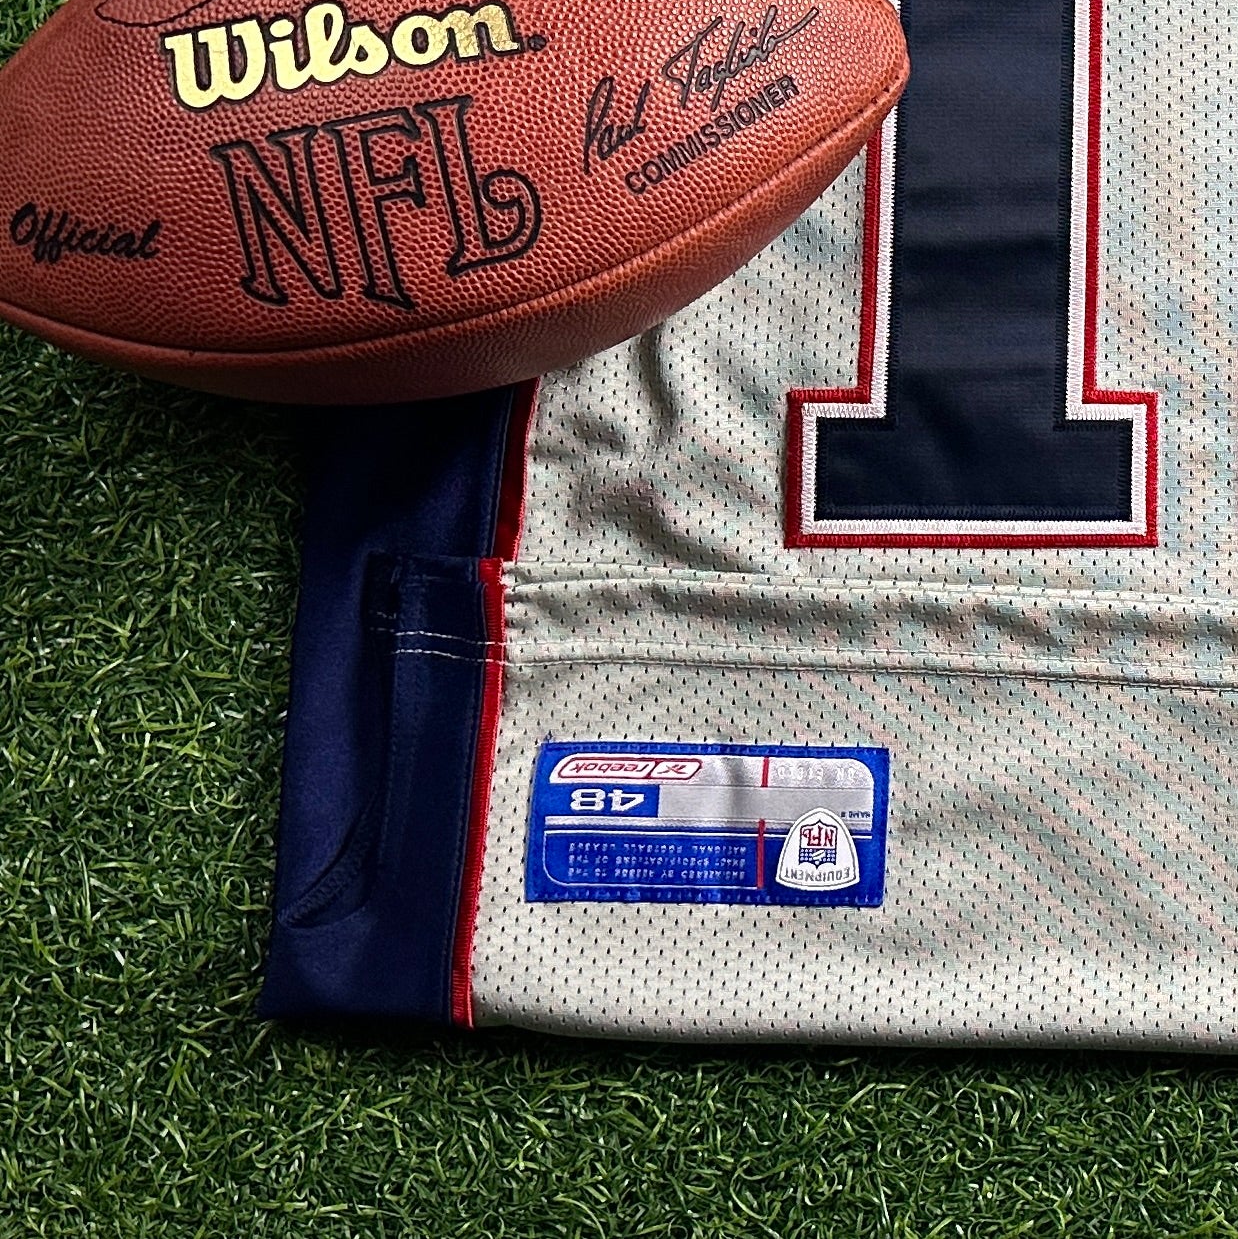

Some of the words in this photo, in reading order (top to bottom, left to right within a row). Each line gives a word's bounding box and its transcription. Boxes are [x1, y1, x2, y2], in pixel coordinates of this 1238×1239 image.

[625, 75, 800, 194] COMMISSIONER
[211, 95, 541, 310] NFL
[10, 202, 162, 264] Official
[569, 762, 649, 775] reebok
[571, 788, 644, 812] 48
[801, 826, 835, 847] NFL
[784, 866, 850, 883] EQUIPMENT
